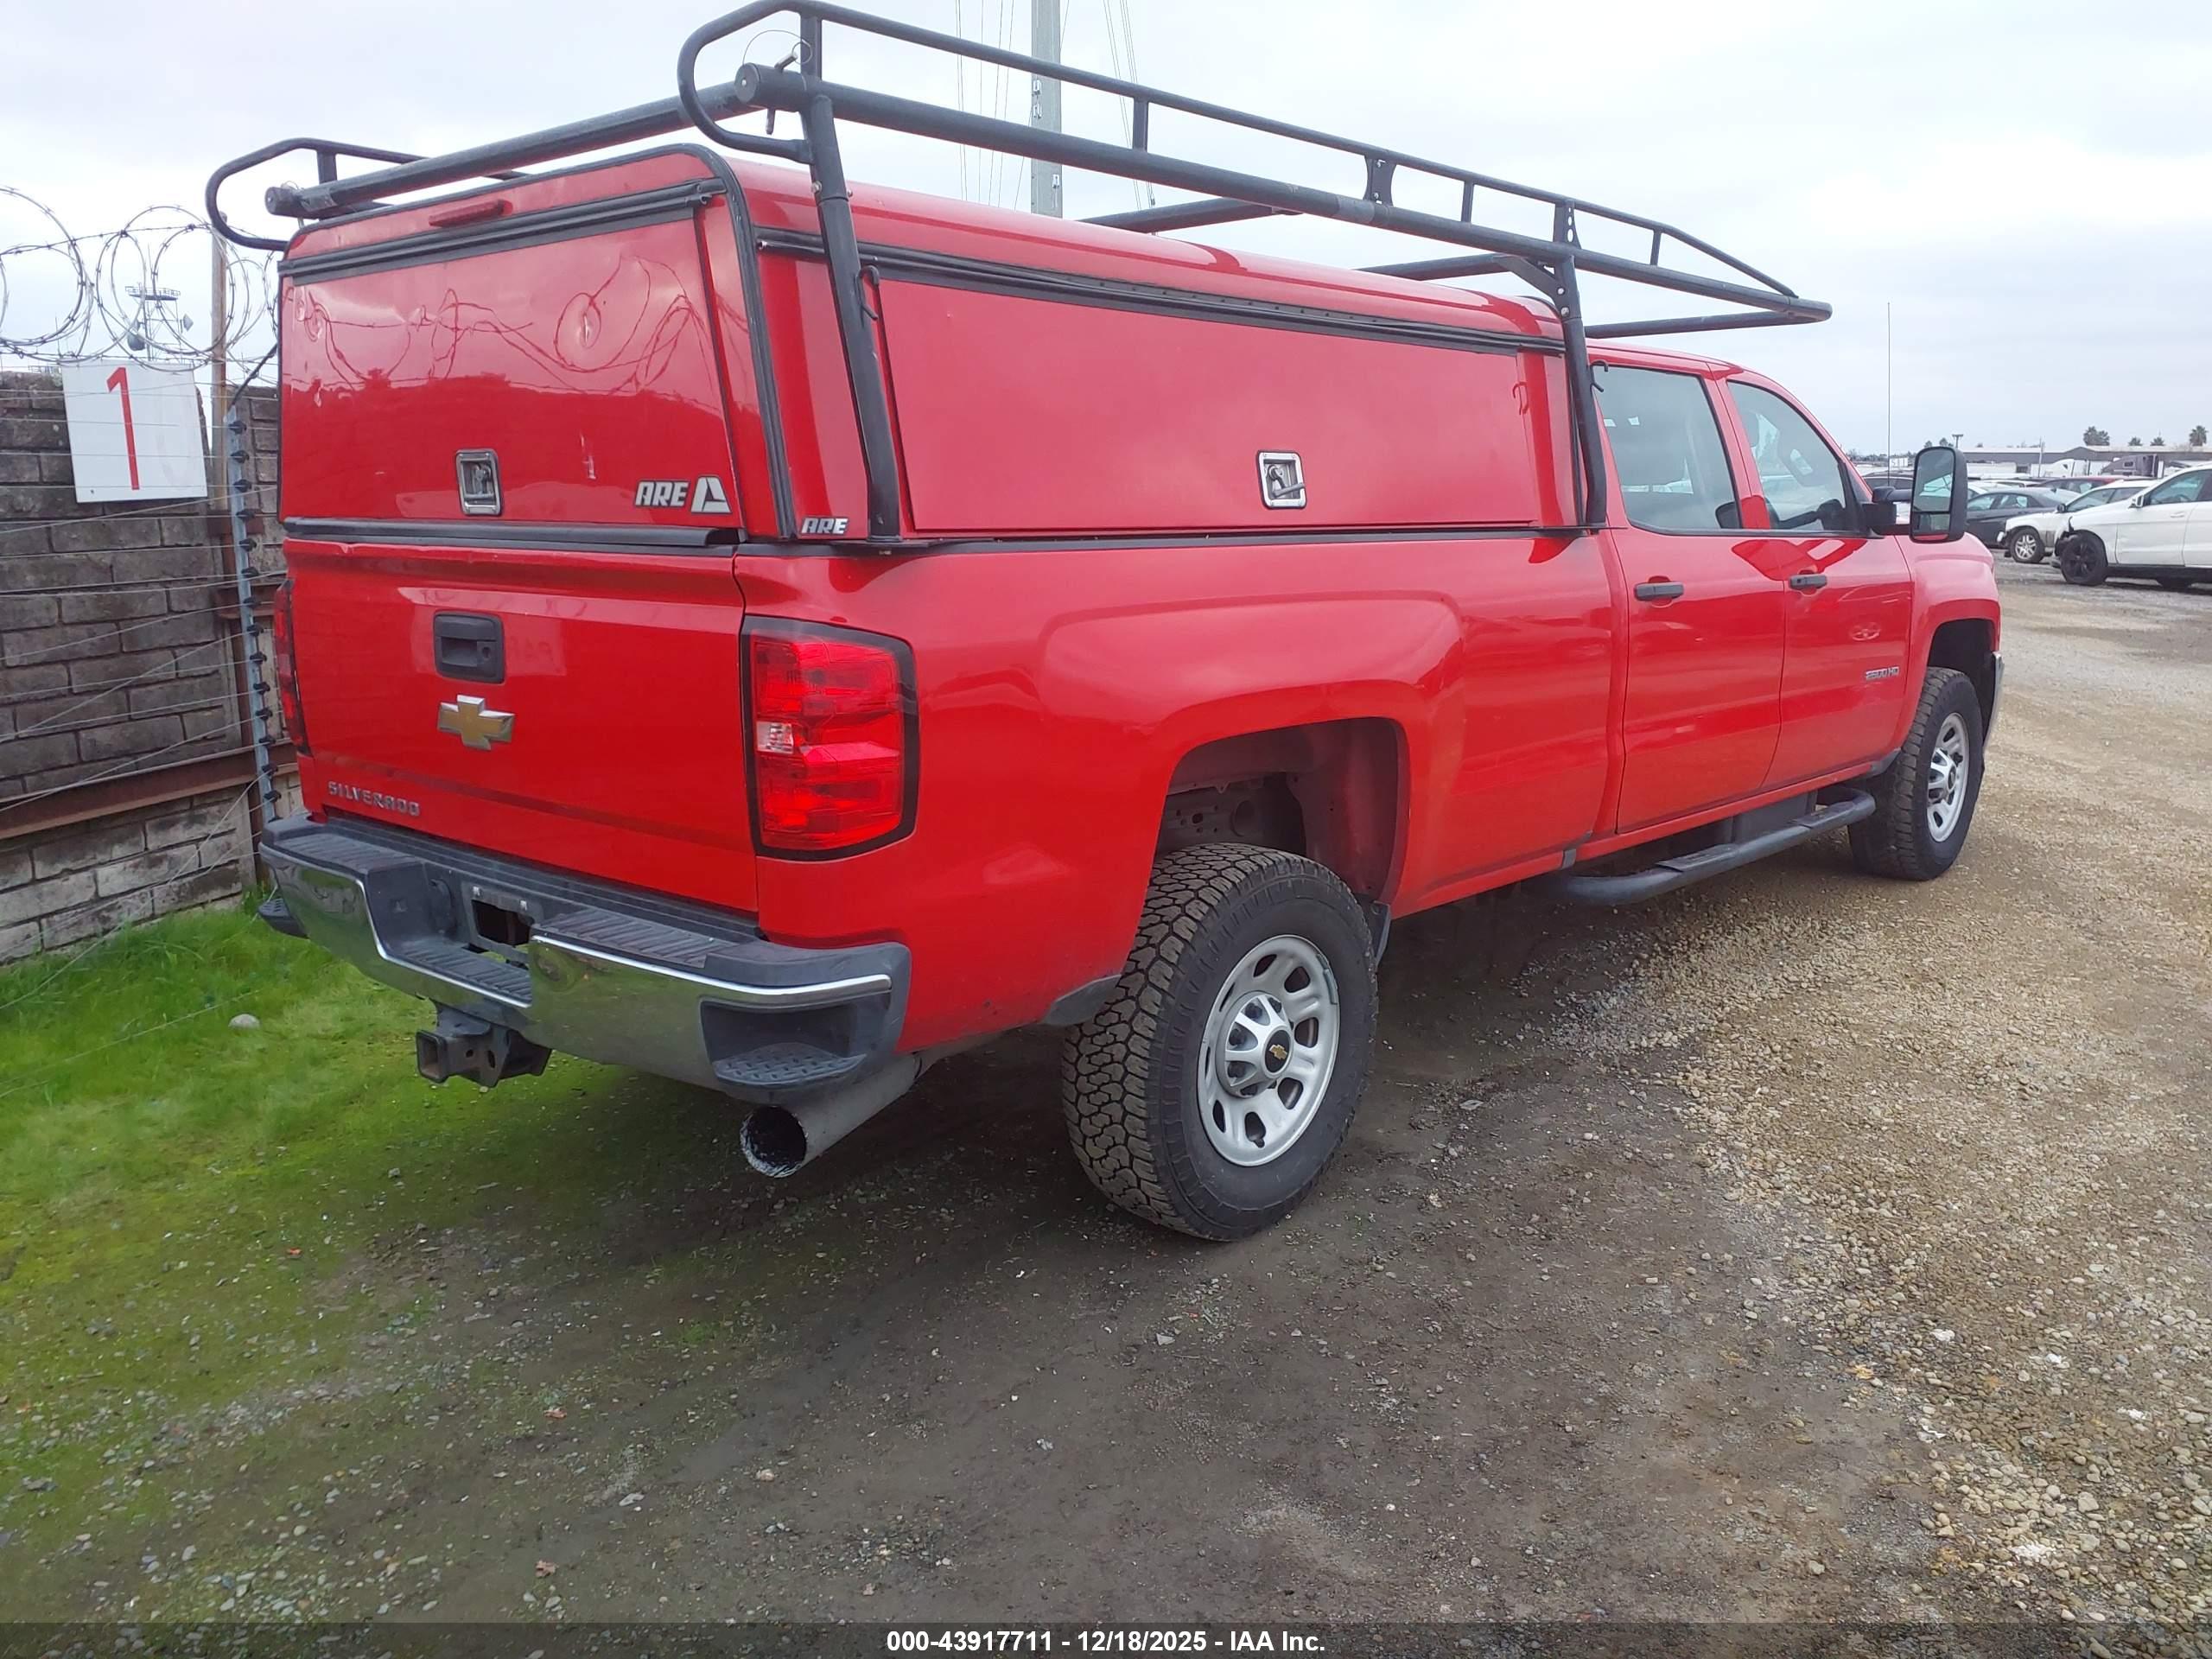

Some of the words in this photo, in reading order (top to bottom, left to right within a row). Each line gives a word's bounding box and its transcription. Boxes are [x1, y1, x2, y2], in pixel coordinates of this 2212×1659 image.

[106, 366, 140, 491] 1
[634, 480, 690, 507] ARE
[801, 517, 849, 535] ARE
[327, 780, 421, 817] SILVERADO
